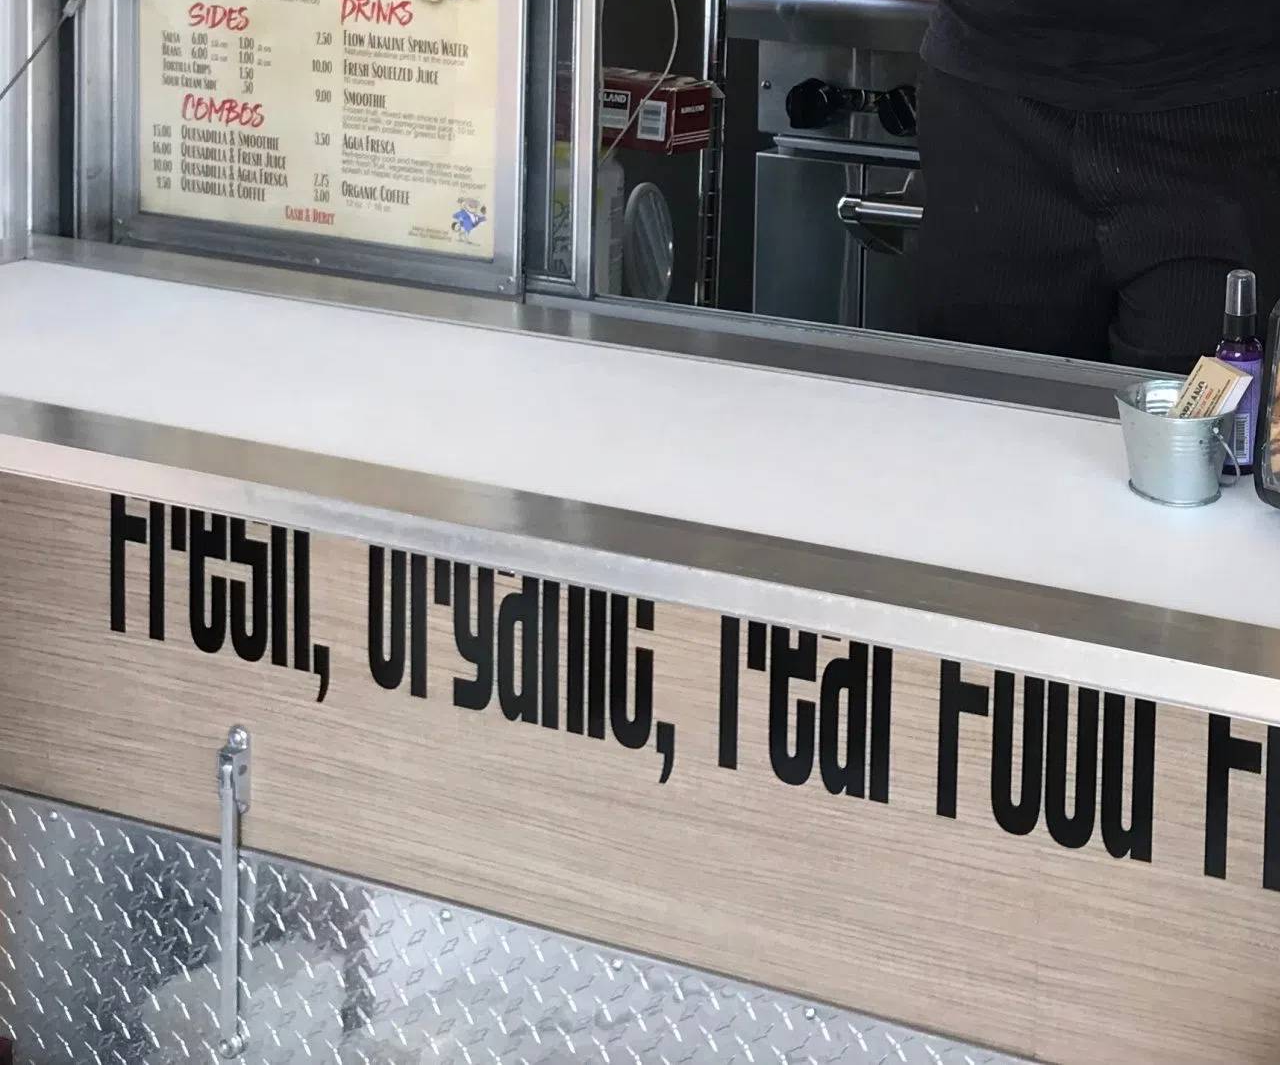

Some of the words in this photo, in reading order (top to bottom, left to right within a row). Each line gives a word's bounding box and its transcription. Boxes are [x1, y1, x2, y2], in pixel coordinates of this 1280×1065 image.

[188, 2, 249, 31] SIDES
[344, 30, 364, 46] FLOW
[368, 32, 405, 51] ALKALINE
[408, 36, 438, 55] SPRING
[441, 40, 469, 58] WATER
[312, 60, 332, 74] 10.00
[344, 58, 369, 76] FRESH
[372, 61, 413, 82] SQUEEZED
[416, 68, 439, 85] JUICE
[182, 94, 264, 128] COMBOS
[315, 90, 332, 102] 9.00
[344, 89, 387, 108] SMOOTHIE
[181, 125, 227, 146] QUESADILLA
[238, 131, 280, 150] SMOOTHIE
[314, 133, 330, 146] 3.50
[342, 134, 364, 151] AGUA
[366, 136, 395, 155] FRESCA
[181, 142, 227, 162] QUESADILLA
[238, 149, 262, 167] FRESH
[264, 153, 286, 170] JUICE
[181, 158, 227, 180] QUESADILLA
[238, 166, 258, 184] AGUA
[260, 170, 288, 188] FRESCA
[181, 176, 227, 196] QUESADILLA
[237, 184, 266, 202] COFFEE
[314, 189, 330, 202] 3.00
[342, 180, 376, 201] ORGANIC
[380, 185, 410, 205] COFFEE
[286, 206, 303, 221] CASH
[312, 208, 336, 225] DEBIT
